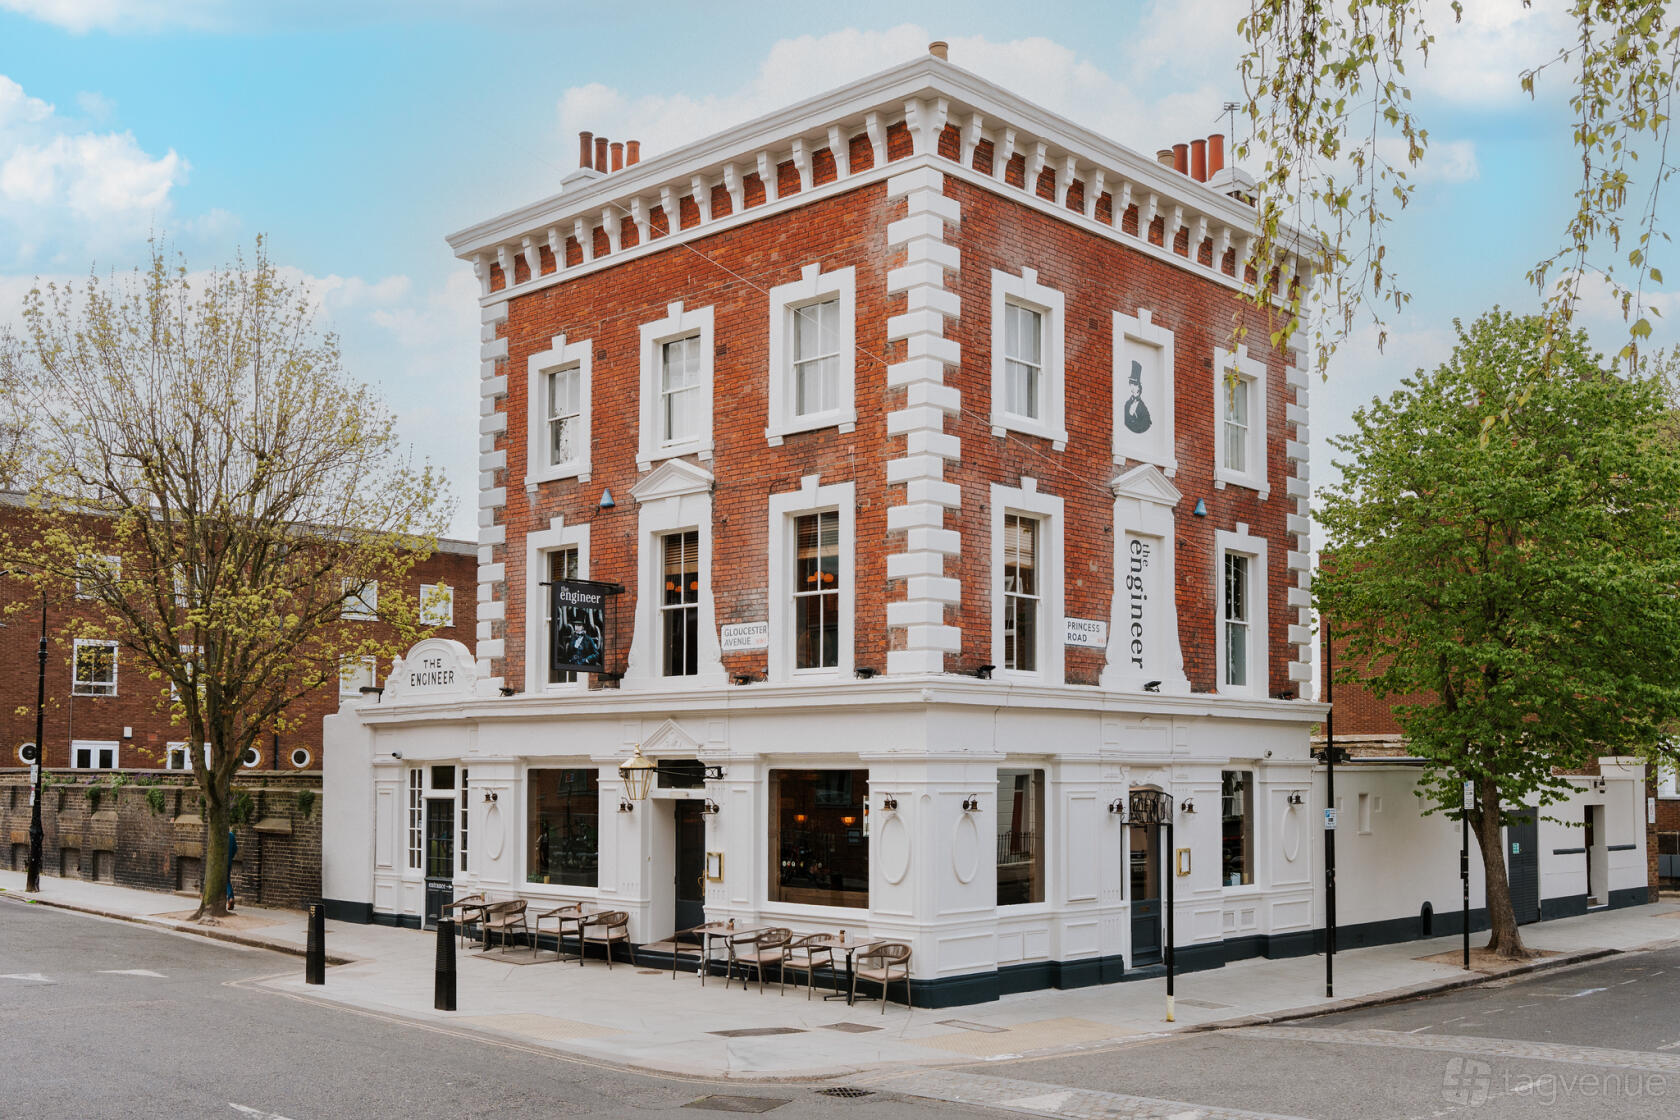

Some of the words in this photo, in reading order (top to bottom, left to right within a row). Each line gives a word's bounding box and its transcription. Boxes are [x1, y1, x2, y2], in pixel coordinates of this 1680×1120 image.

[1142, 544, 1150, 567] the
[560, 589, 601, 604] engineer
[1126, 539, 1147, 670] engineer
[724, 625, 767, 637] GLOUCESTER
[1067, 621, 1100, 633] PRINCESS
[724, 637, 752, 647] AVENUE
[1067, 632, 1087, 642] ROAD
[423, 658, 442, 669] THE
[410, 670, 454, 687] ENGINEER
